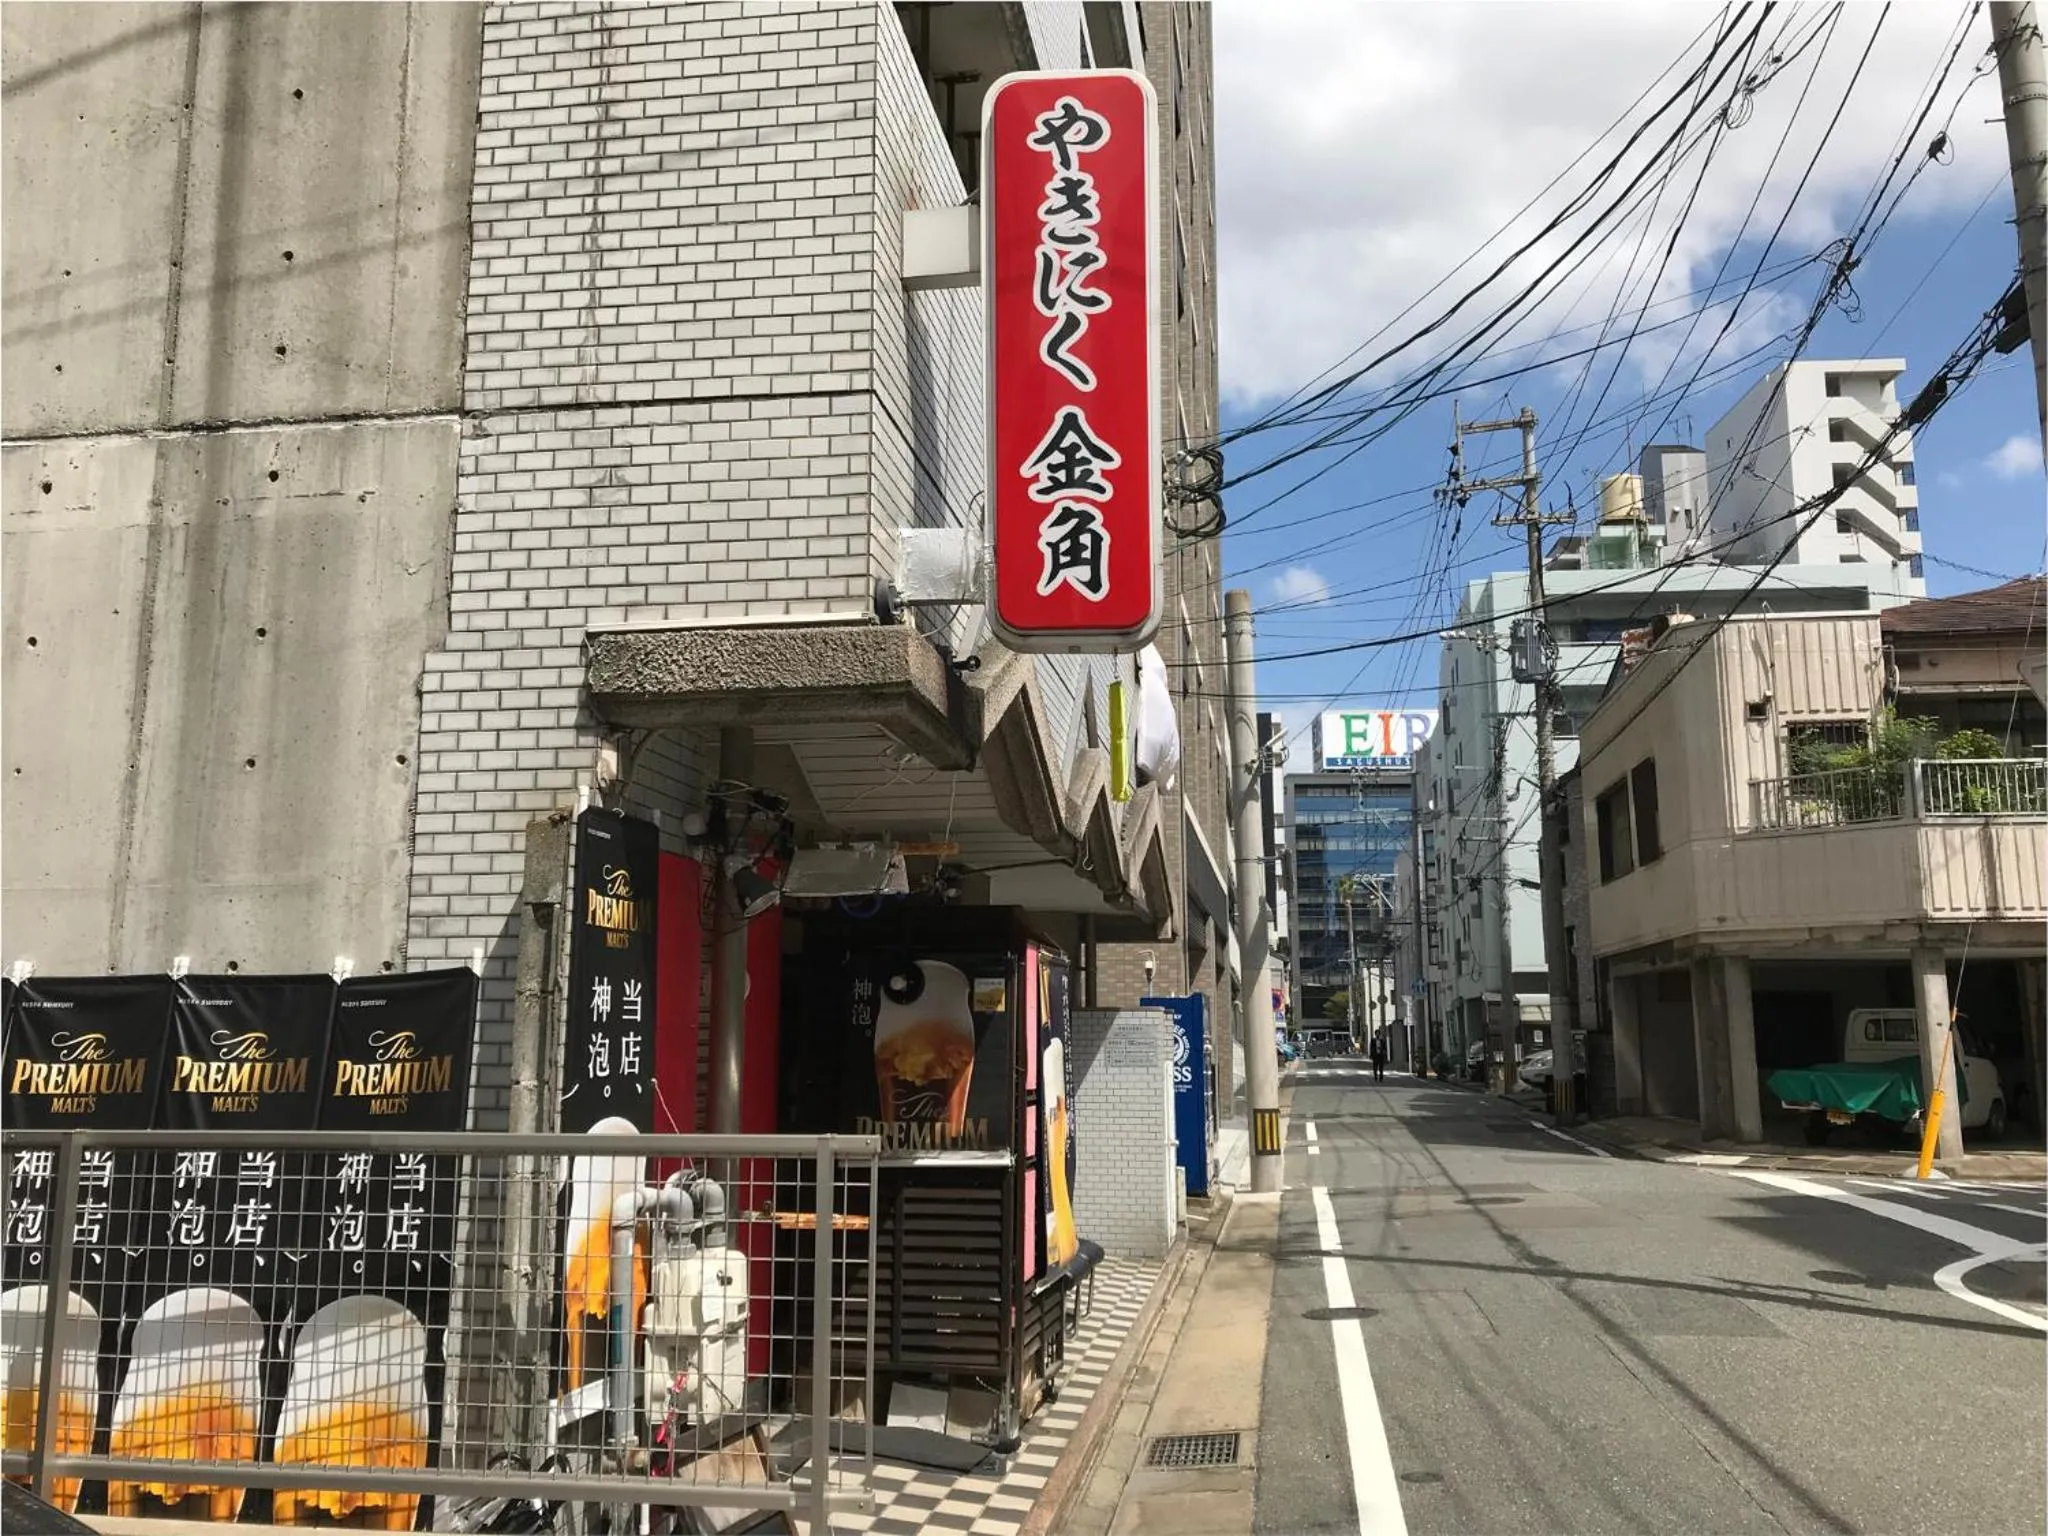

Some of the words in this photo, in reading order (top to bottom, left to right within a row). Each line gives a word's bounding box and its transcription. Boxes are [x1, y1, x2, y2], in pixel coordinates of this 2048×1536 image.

[1028, 98, 1110, 390] やきにく
[1022, 407, 1119, 599] 金角
[602, 864, 634, 897] The
[51, 1031, 115, 1061] The
[209, 1030, 278, 1060] The
[368, 1030, 424, 1061] The
[10, 1058, 148, 1095] PREMIUM
[170, 1056, 311, 1093] PREMIUM
[333, 1054, 454, 1097] PREMIUM
[51, 1095, 98, 1114] MALT'S
[211, 1094, 260, 1113] MALT'S
[369, 1095, 410, 1115] MALT'S
